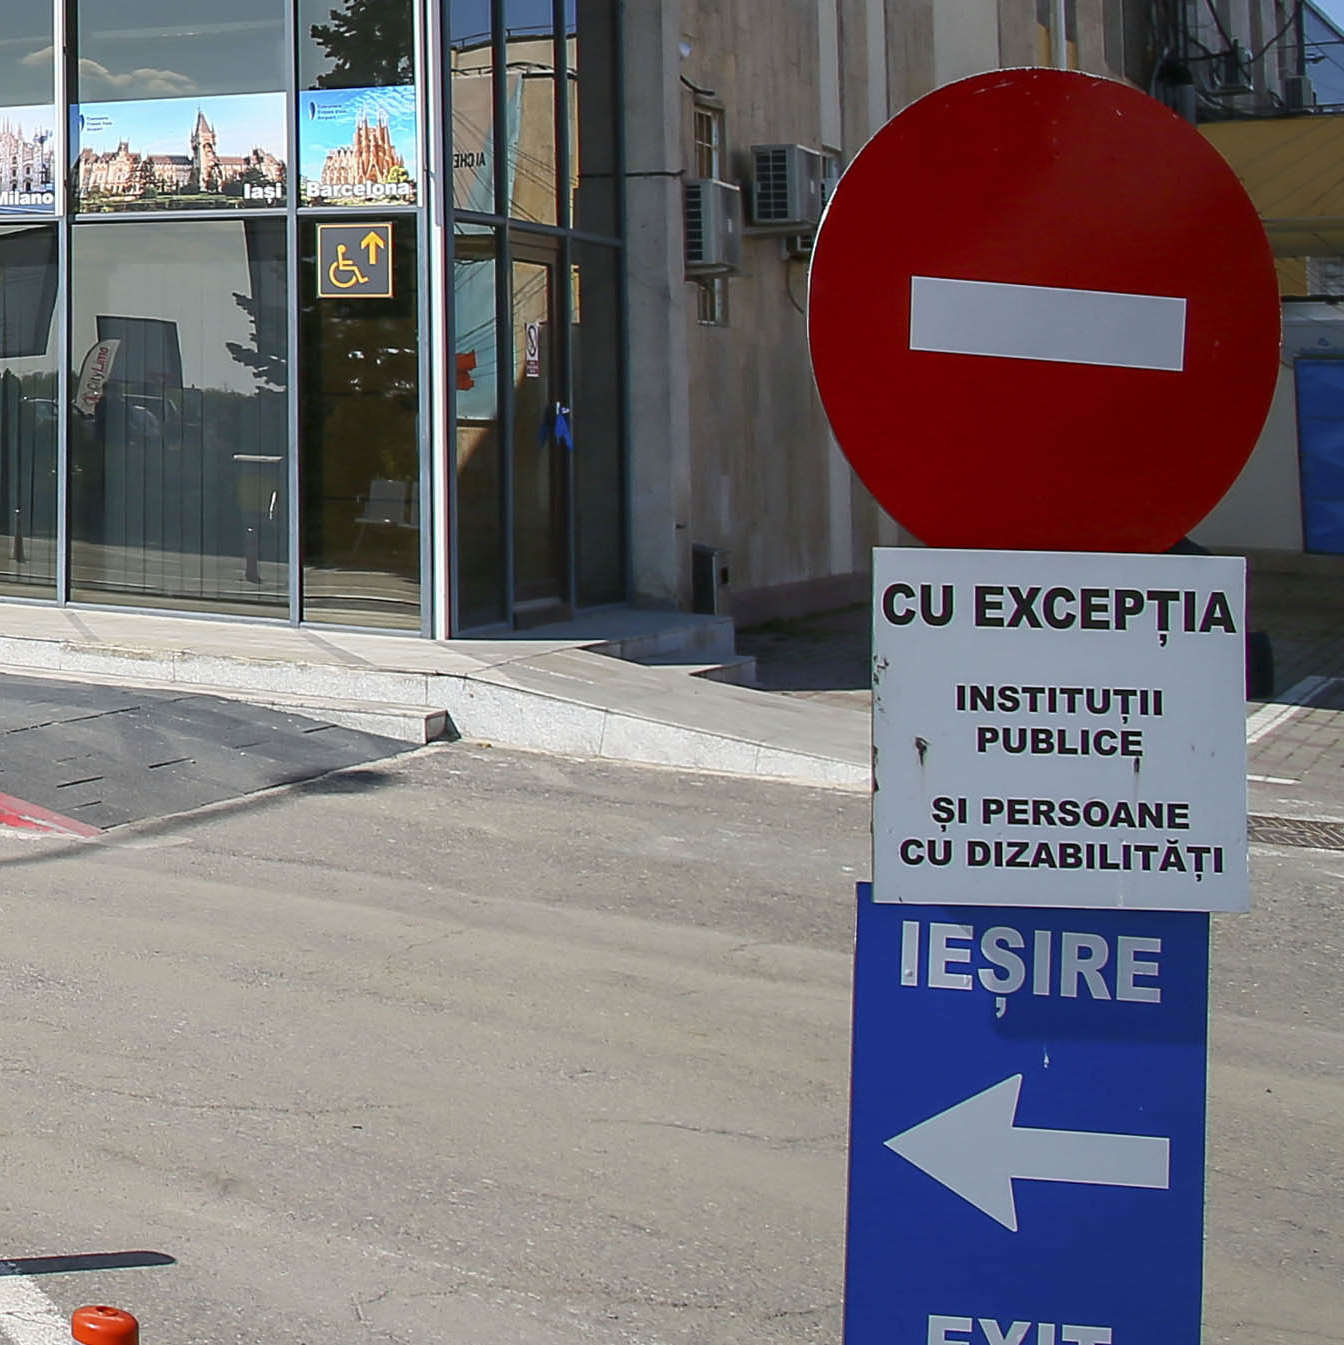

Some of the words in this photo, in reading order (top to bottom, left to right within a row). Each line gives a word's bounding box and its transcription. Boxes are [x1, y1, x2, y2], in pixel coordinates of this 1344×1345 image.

[244, 182, 282, 205] Iași
[307, 180, 410, 199] Barcelona
[882, 583, 955, 627] CU
[974, 585, 1238, 648] EXCEPȚIA
[956, 684, 1164, 725] INSTITUȚII
[976, 726, 1144, 757] PUBLICE
[931, 797, 968, 833] ȘI
[981, 797, 1191, 830] PERSOANE
[899, 839, 953, 866] CU
[966, 838, 1224, 883] DIZABILITĂȚI
[897, 920, 1163, 1018] IEȘIRE
